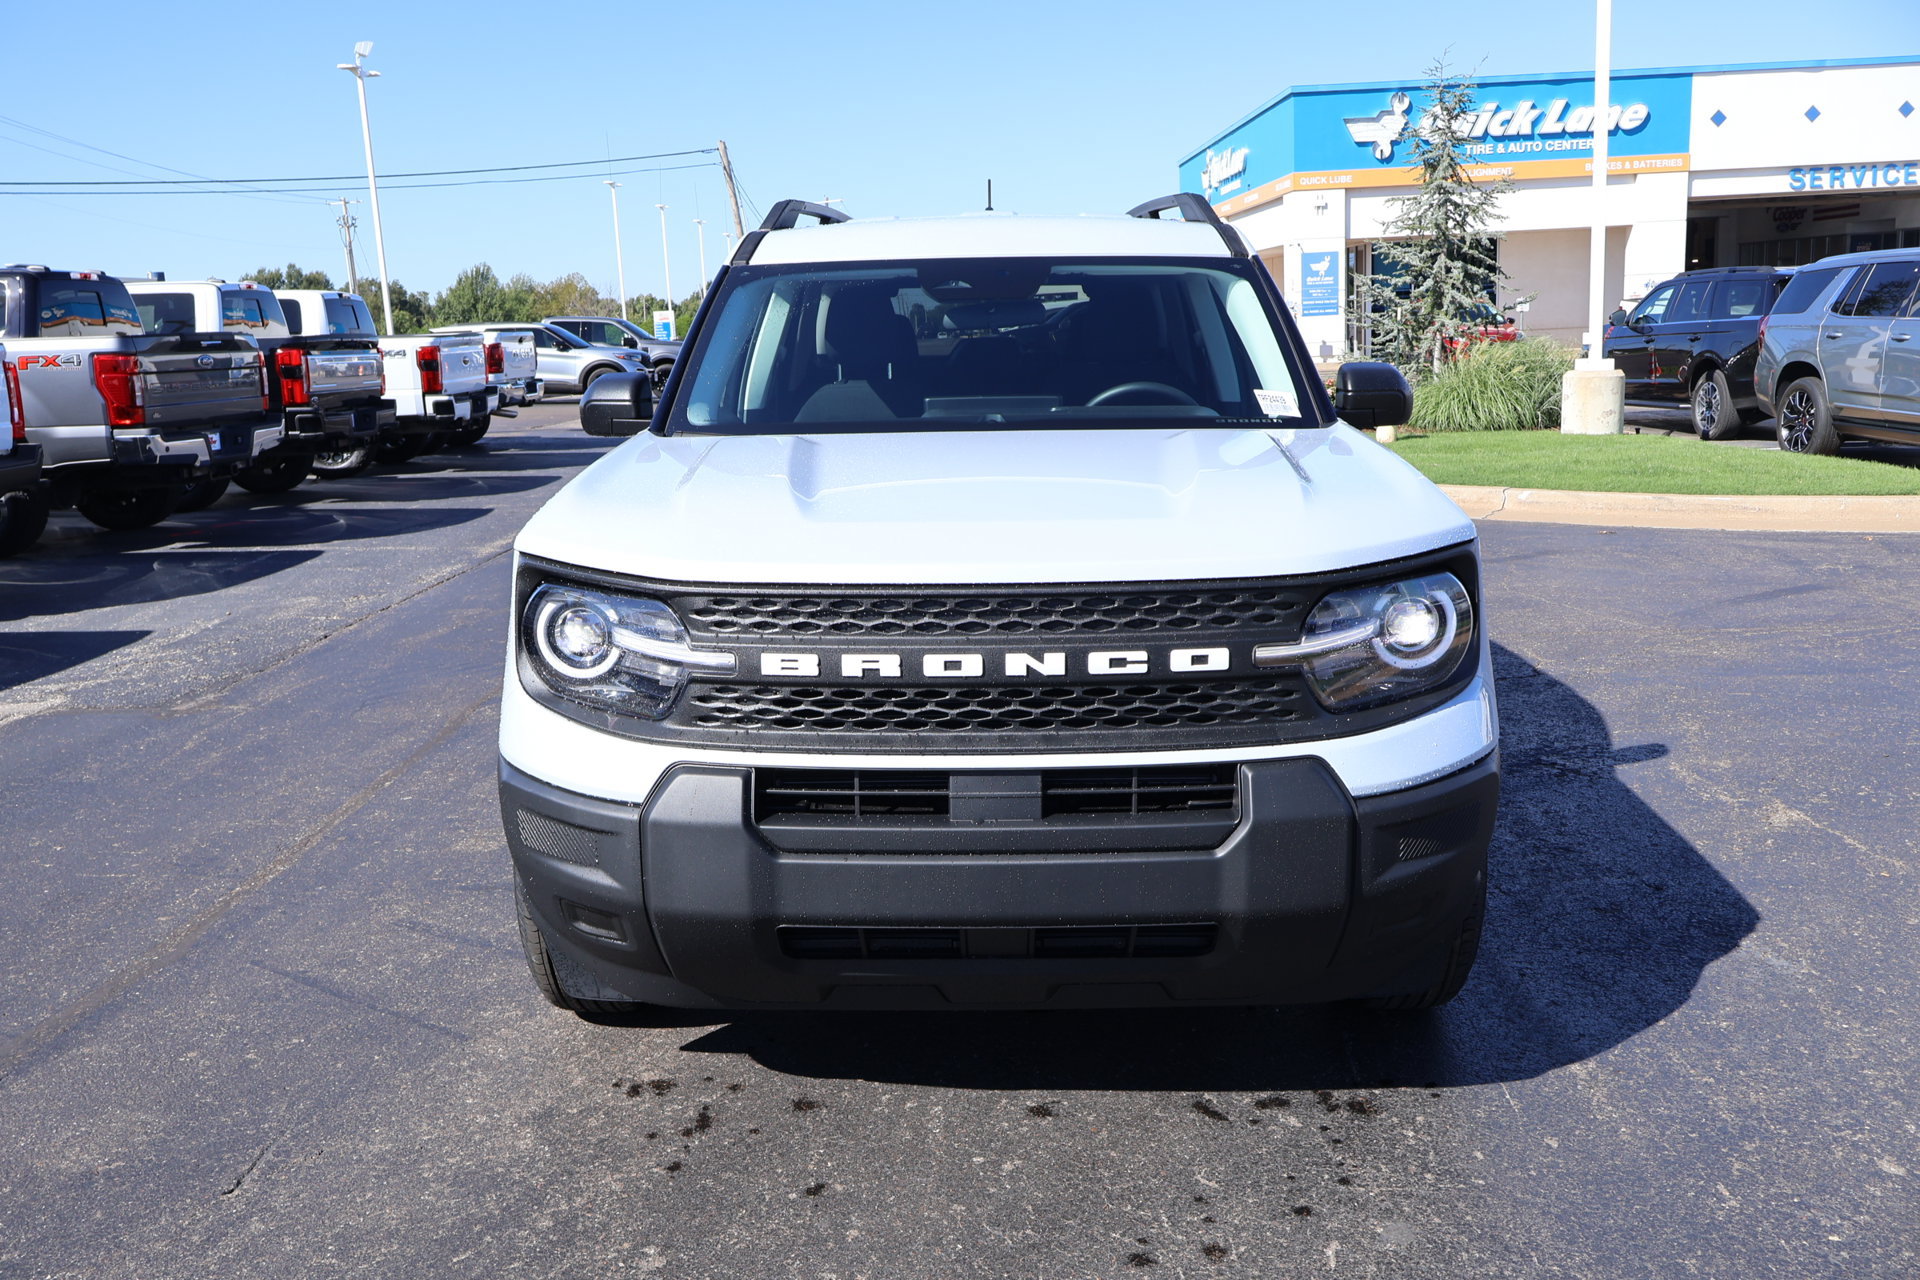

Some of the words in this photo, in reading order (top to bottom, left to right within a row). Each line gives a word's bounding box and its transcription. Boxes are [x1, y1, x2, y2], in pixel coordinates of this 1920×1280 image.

[1465, 144, 1494, 155] TIRE
[1497, 144, 1506, 154] &
[1508, 140, 1542, 153] AUTO
[1545, 138, 1595, 151] CENTER
[1633, 158, 1683, 169] BATTERIES
[1300, 176, 1327, 185] QUICK
[1329, 175, 1353, 184] LUBE
[1788, 163, 1918, 191] SERVICE
[18, 354, 82, 370] FX4
[760, 647, 1230, 677] BRONCO
